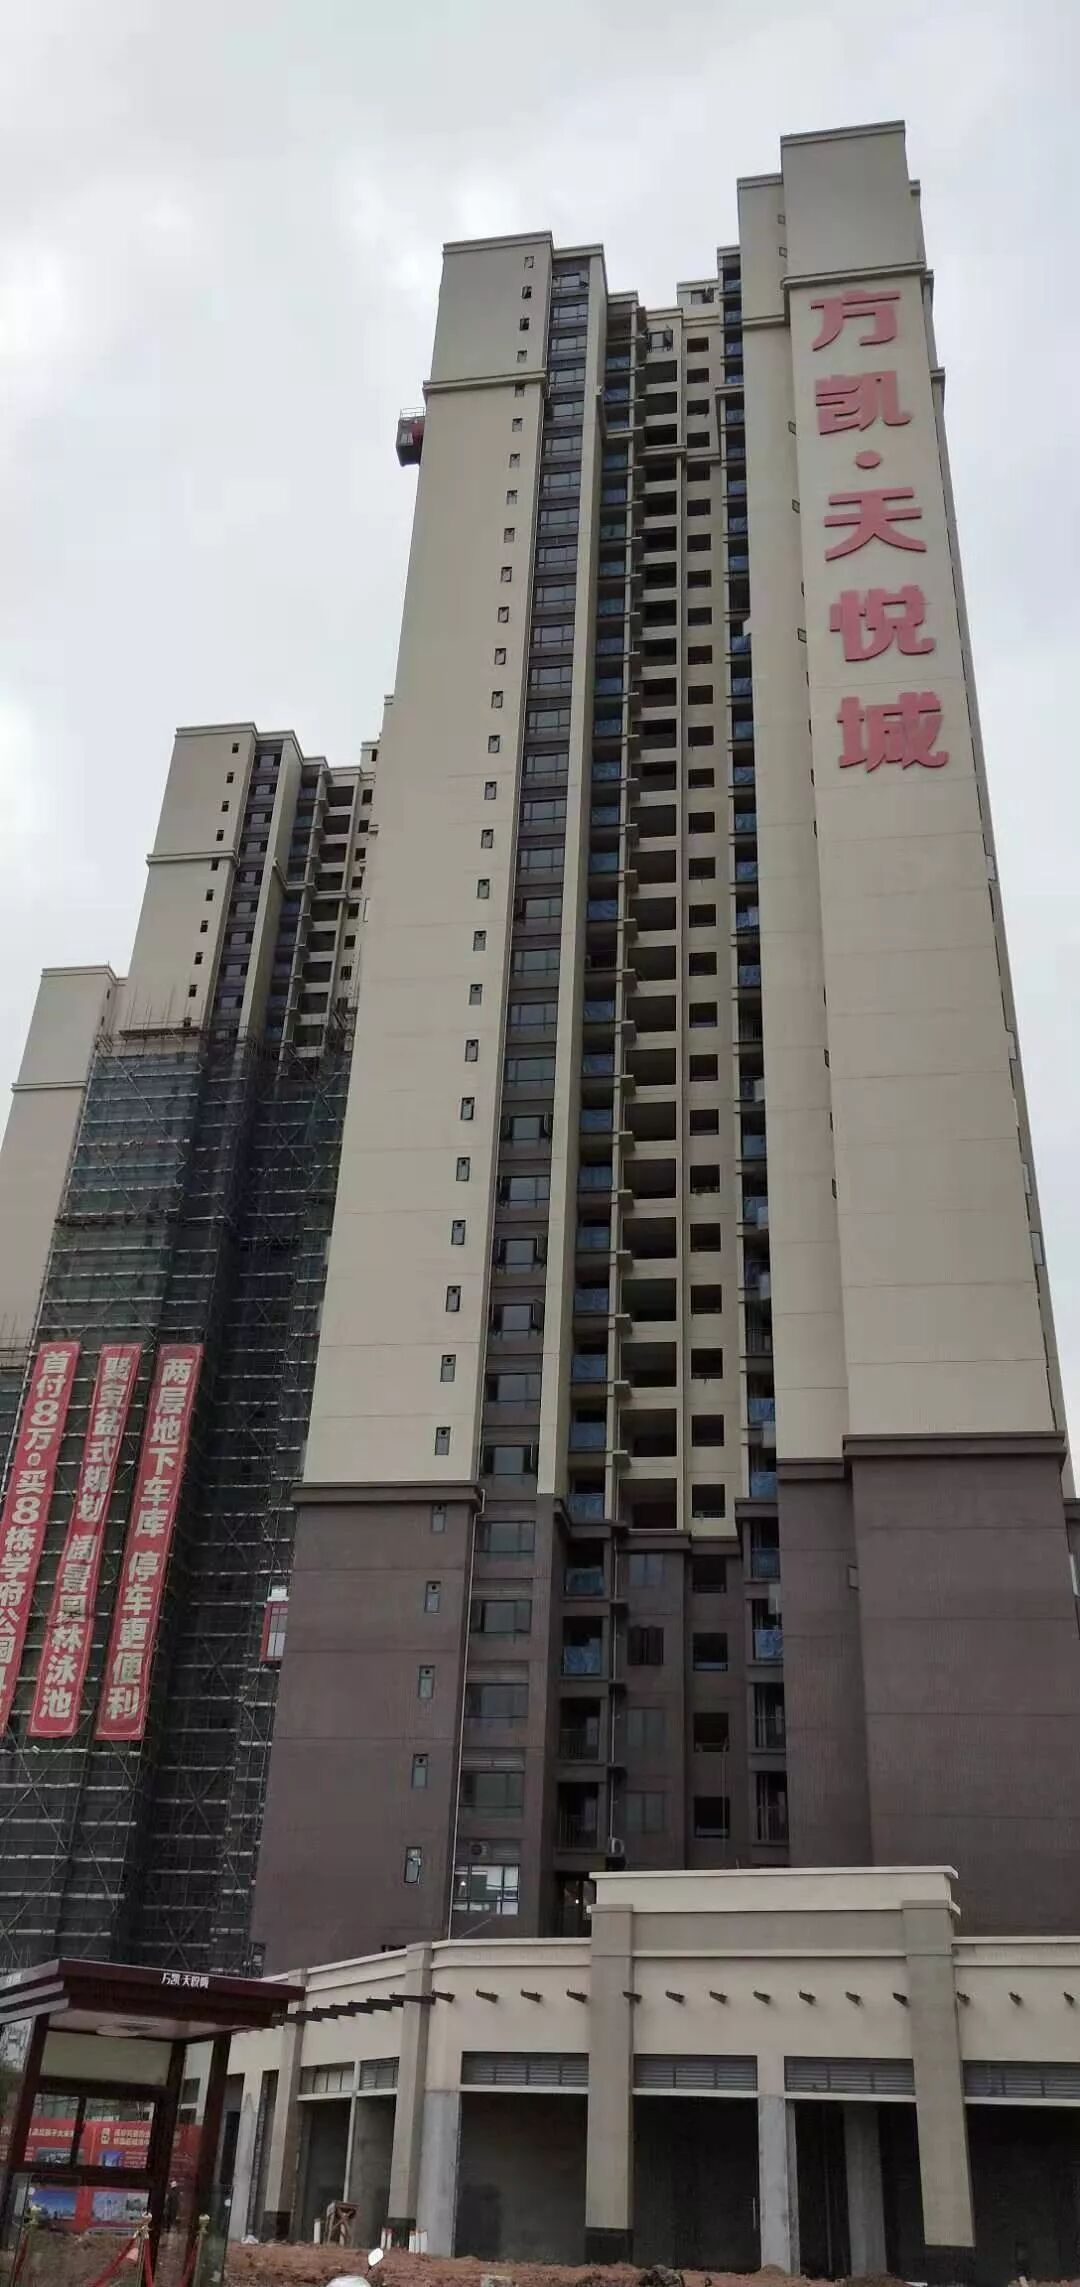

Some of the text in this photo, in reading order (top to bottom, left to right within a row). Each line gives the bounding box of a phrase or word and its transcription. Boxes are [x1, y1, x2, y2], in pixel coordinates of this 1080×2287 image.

[105, 1358, 194, 1721] 两层地下车库 停车更便利
